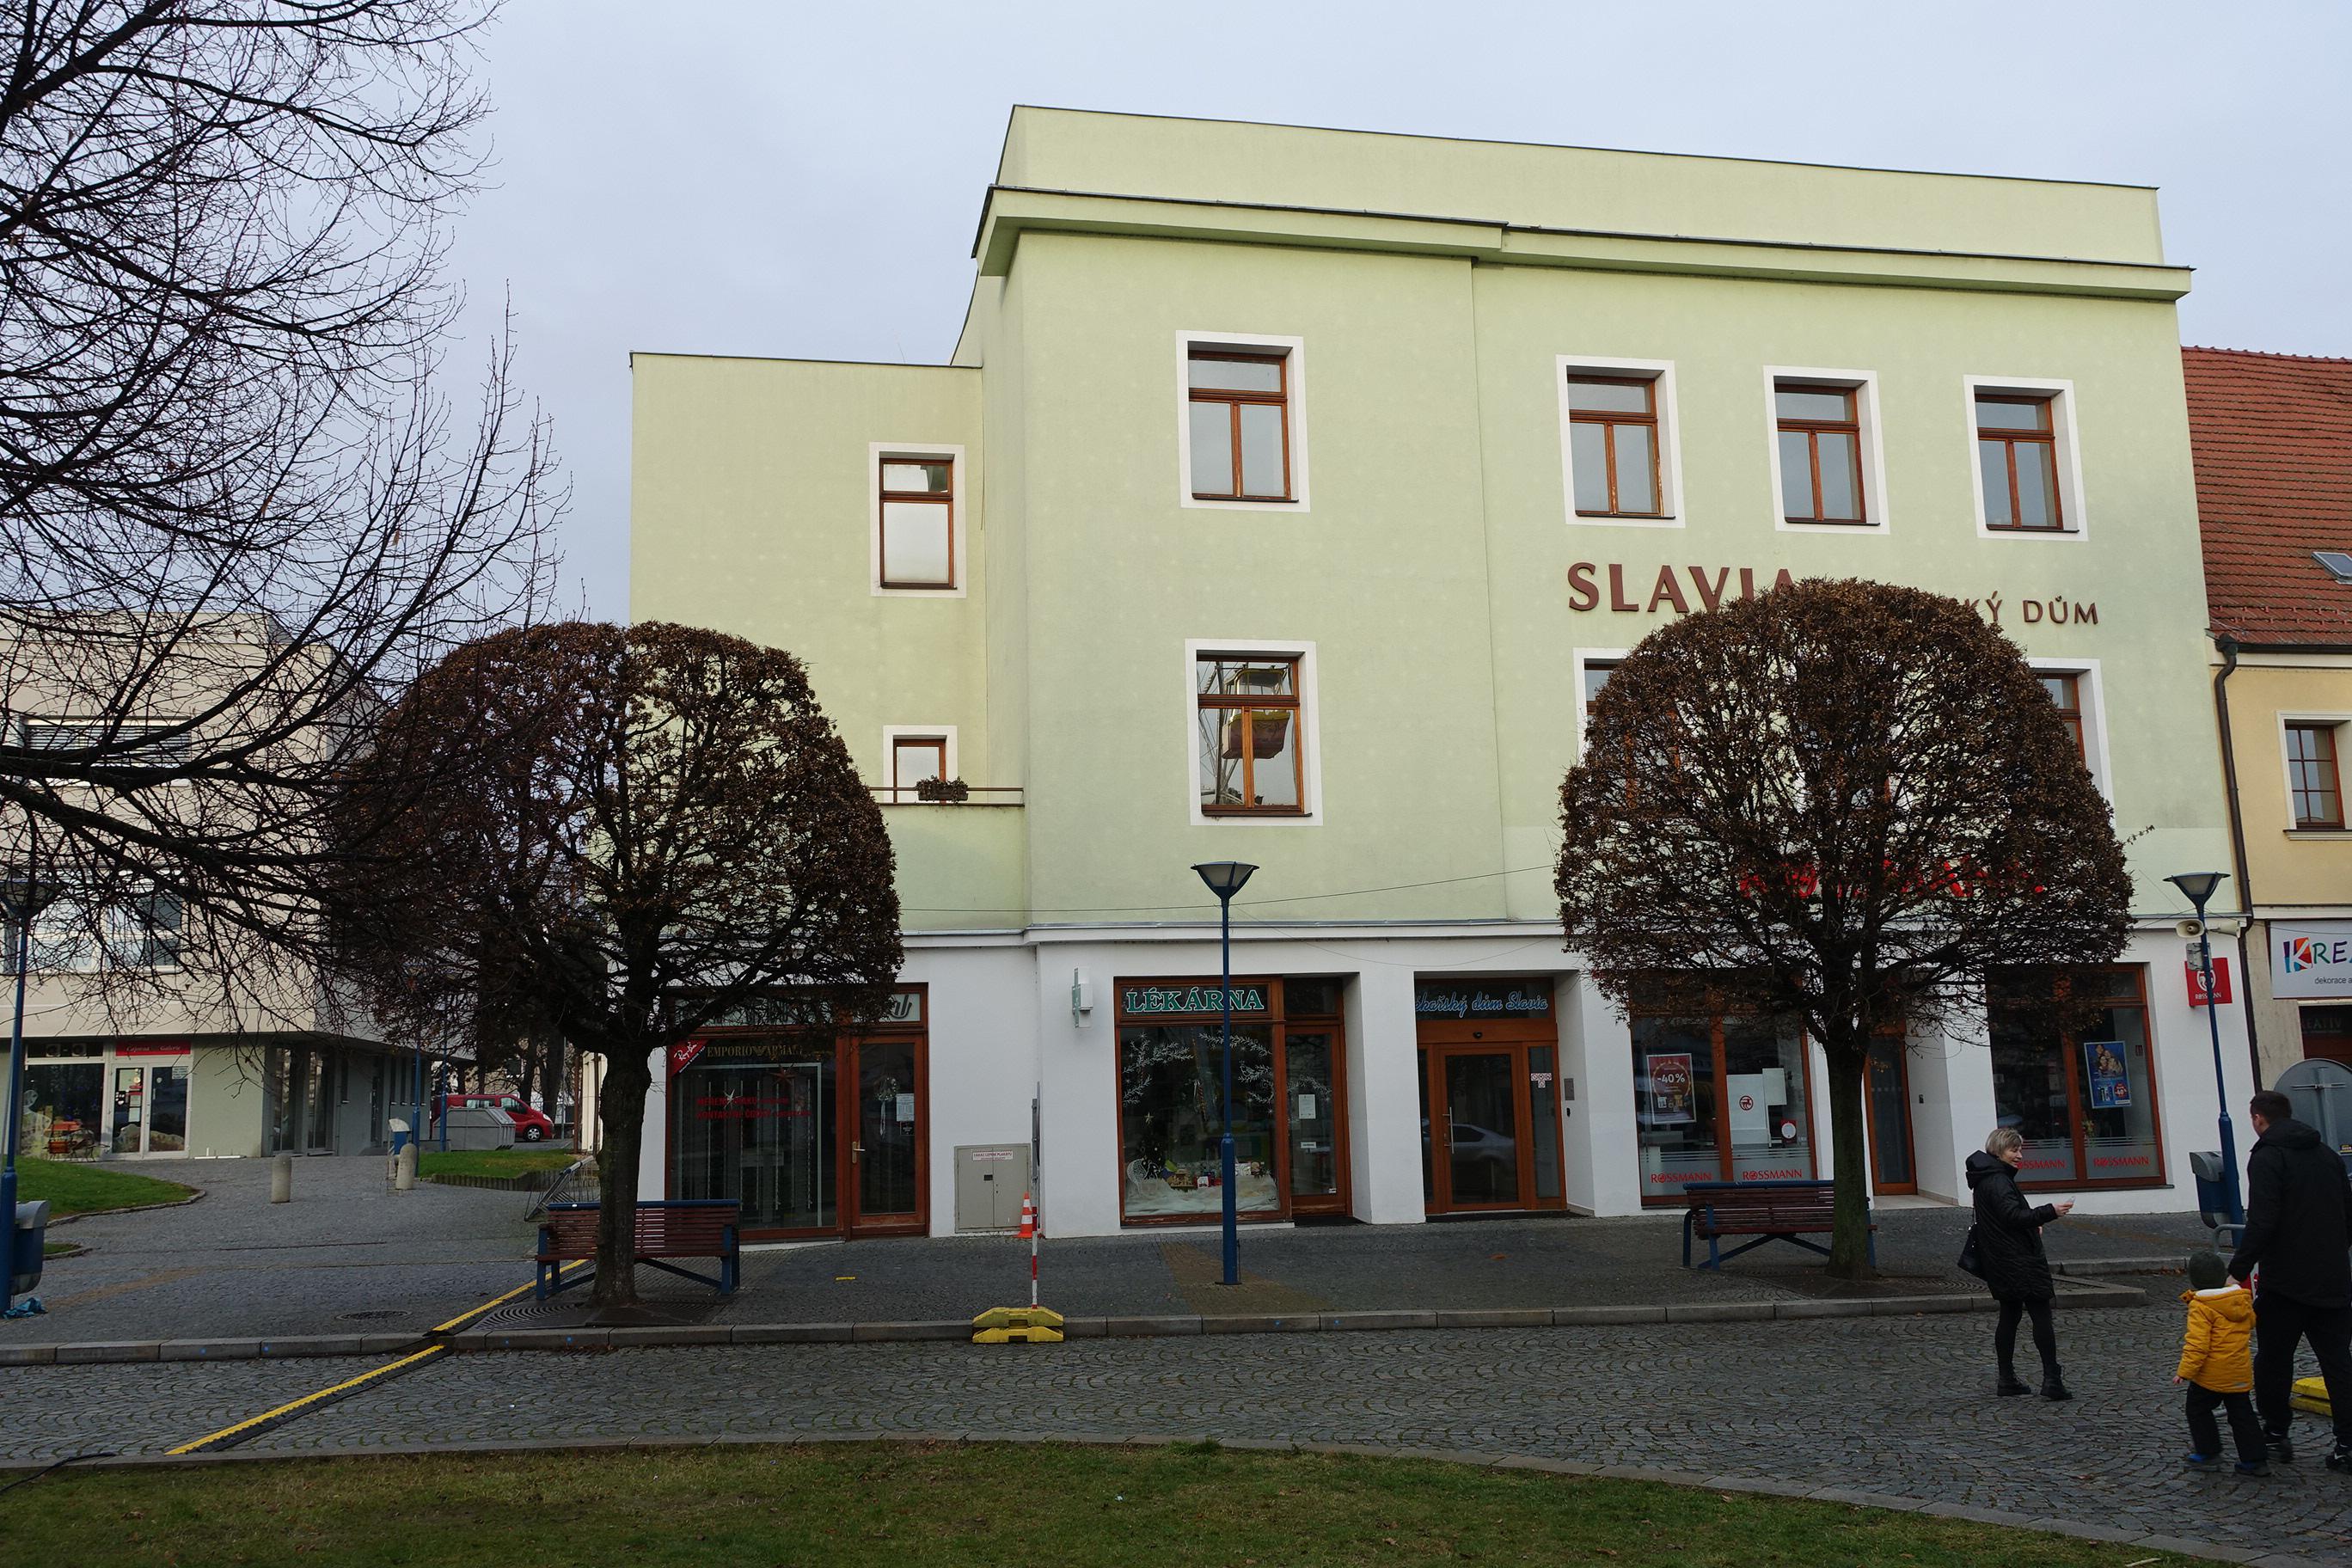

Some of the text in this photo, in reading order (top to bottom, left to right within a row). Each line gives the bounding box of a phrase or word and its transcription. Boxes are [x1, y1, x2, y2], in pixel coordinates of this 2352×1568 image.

[2023, 595, 2098, 625] DŮM
[2283, 937, 2352, 973] KRE
[1126, 986, 1265, 1013] LÉKÁRNA
[1471, 990, 1504, 1011] dům
[1505, 990, 1548, 1011] Slavia
[707, 1045, 752, 1058] EMPORIO
[2016, 1158, 2066, 1170] OSSMANN
[2092, 1156, 2150, 1168] ROSSMANN
[1651, 1172, 1713, 1184] ROSSMANN
[1742, 1169, 1803, 1180] ROSSMANN
